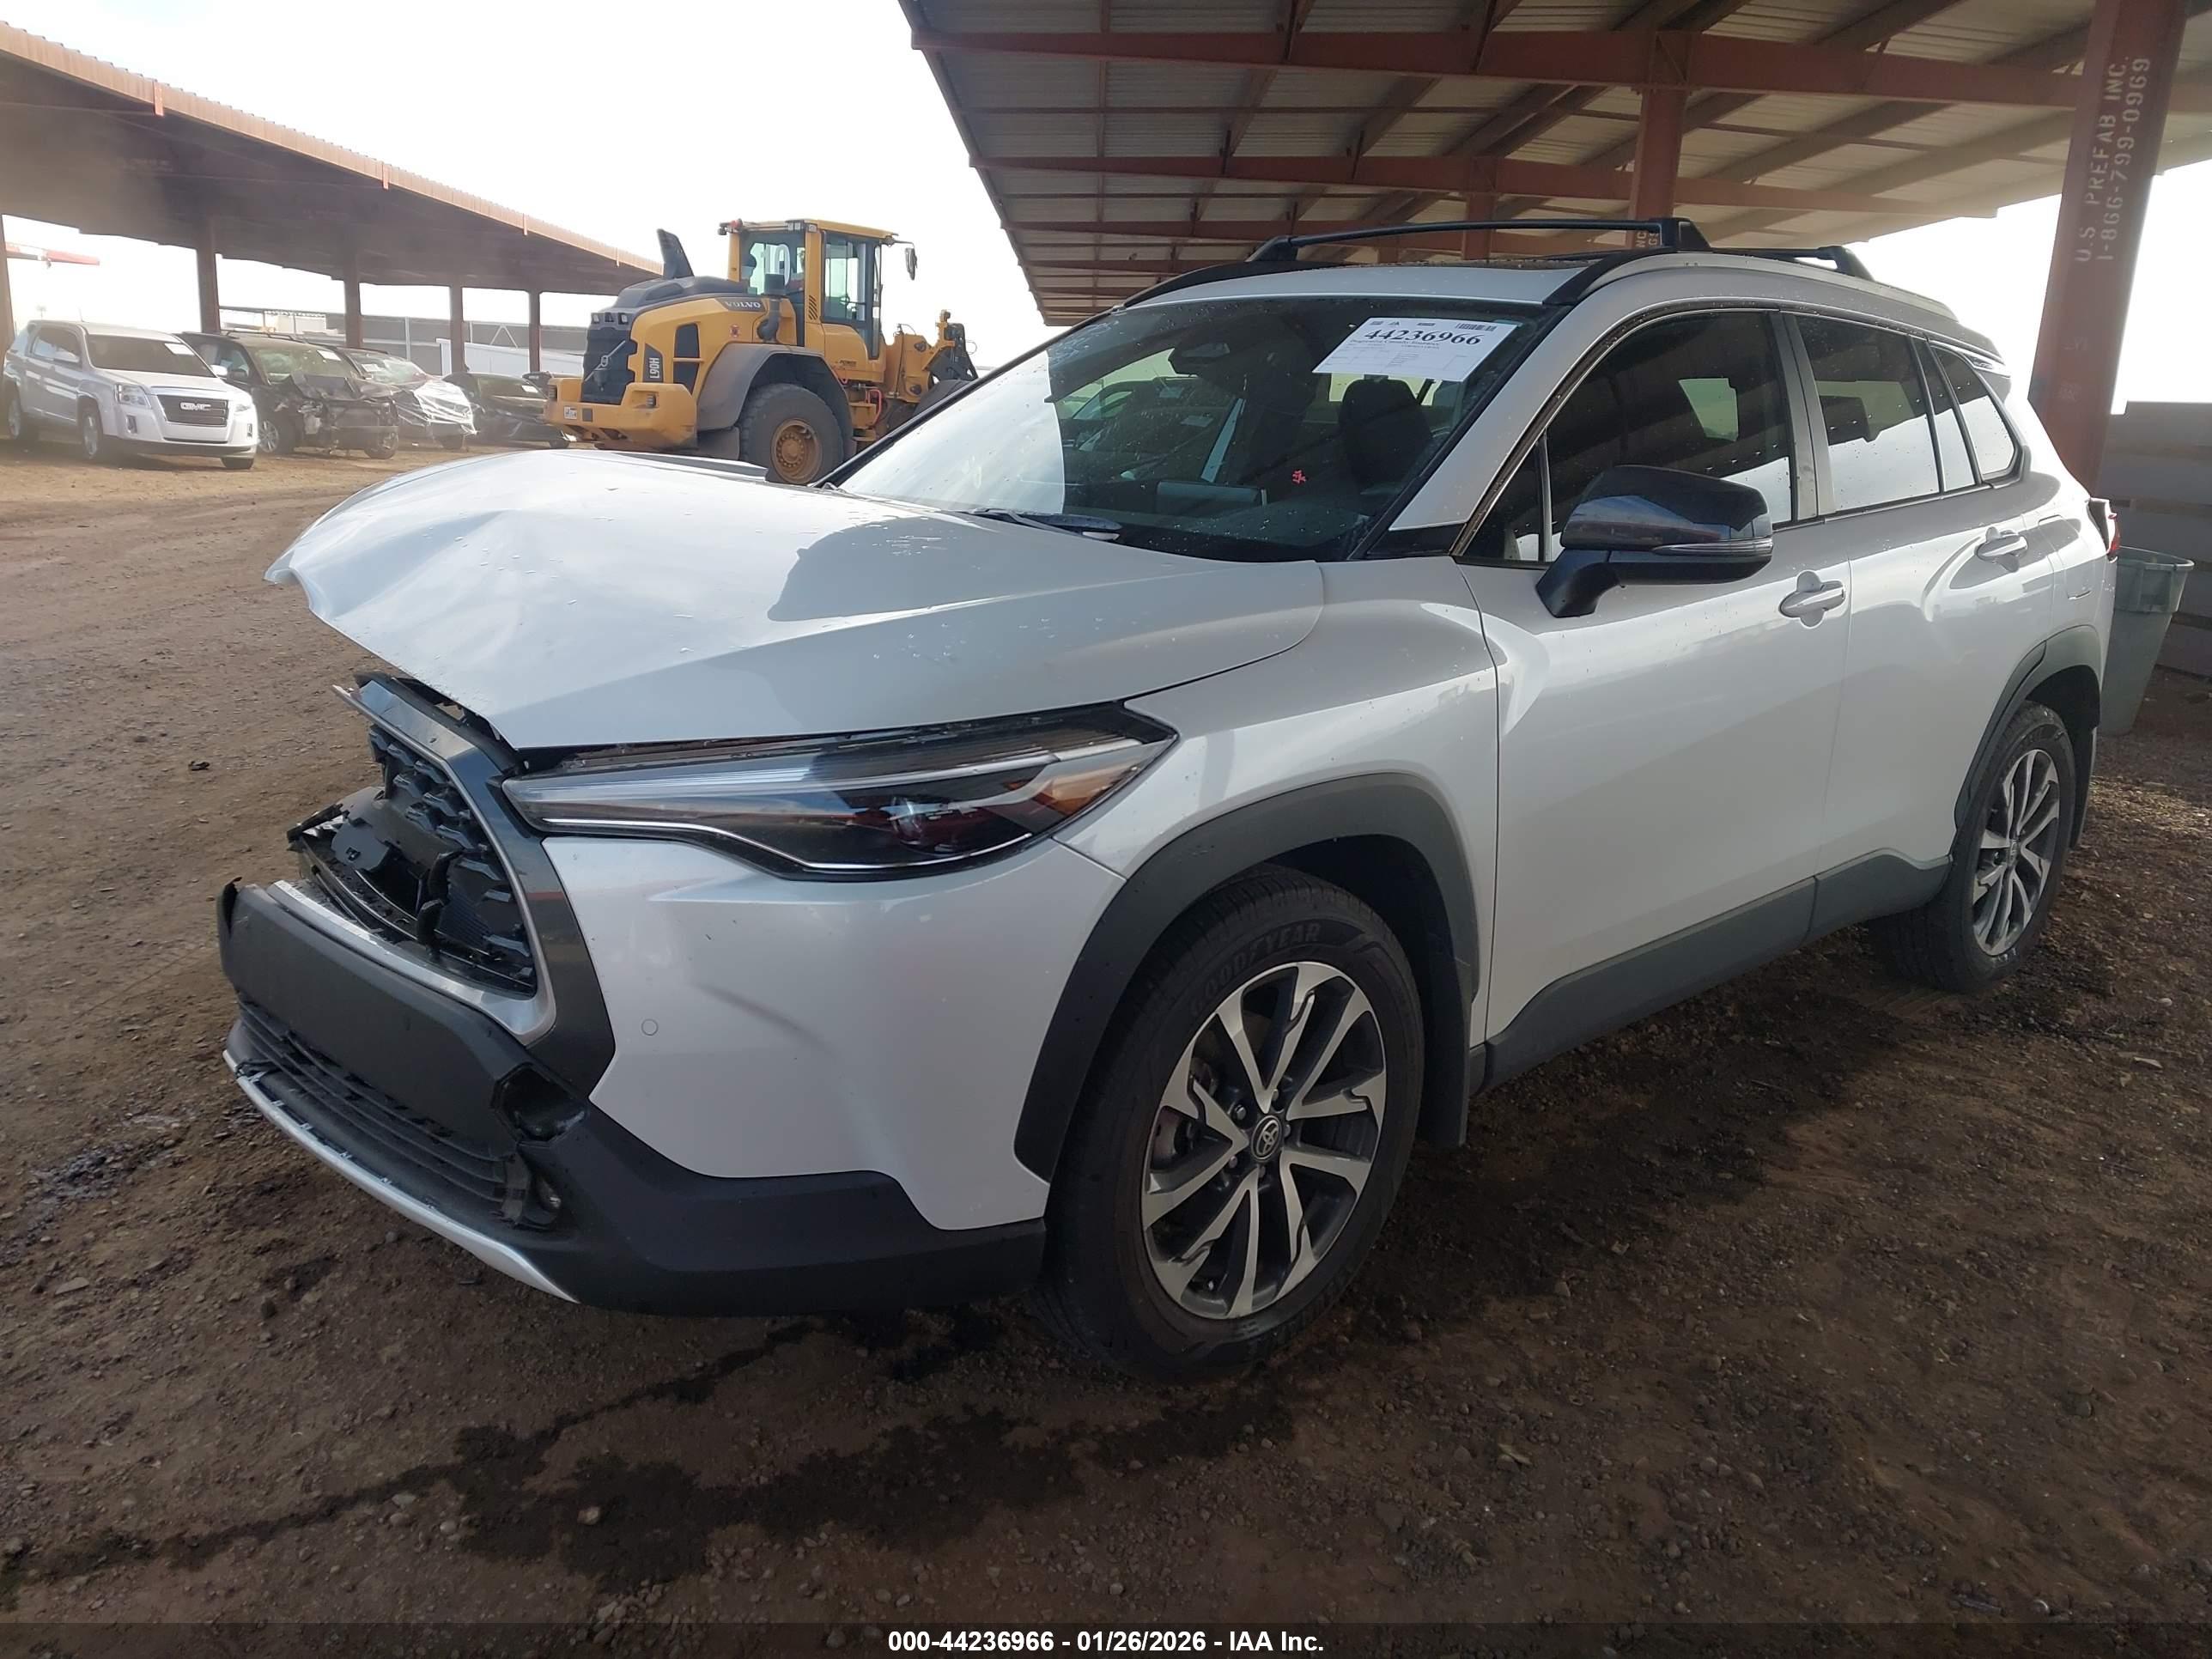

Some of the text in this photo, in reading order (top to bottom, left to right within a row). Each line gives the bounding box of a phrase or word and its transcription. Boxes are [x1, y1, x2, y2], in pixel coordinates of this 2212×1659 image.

[2084, 114, 2117, 205] PREFAB
[2104, 56, 2130, 101] INC.
[2096, 58, 2151, 261] 1-866-799-0969
[725, 301, 762, 309] VOLVO
[1364, 329, 1485, 345] 44236966
[649, 357, 660, 379] L90H
[179, 402, 212, 411] GMC
